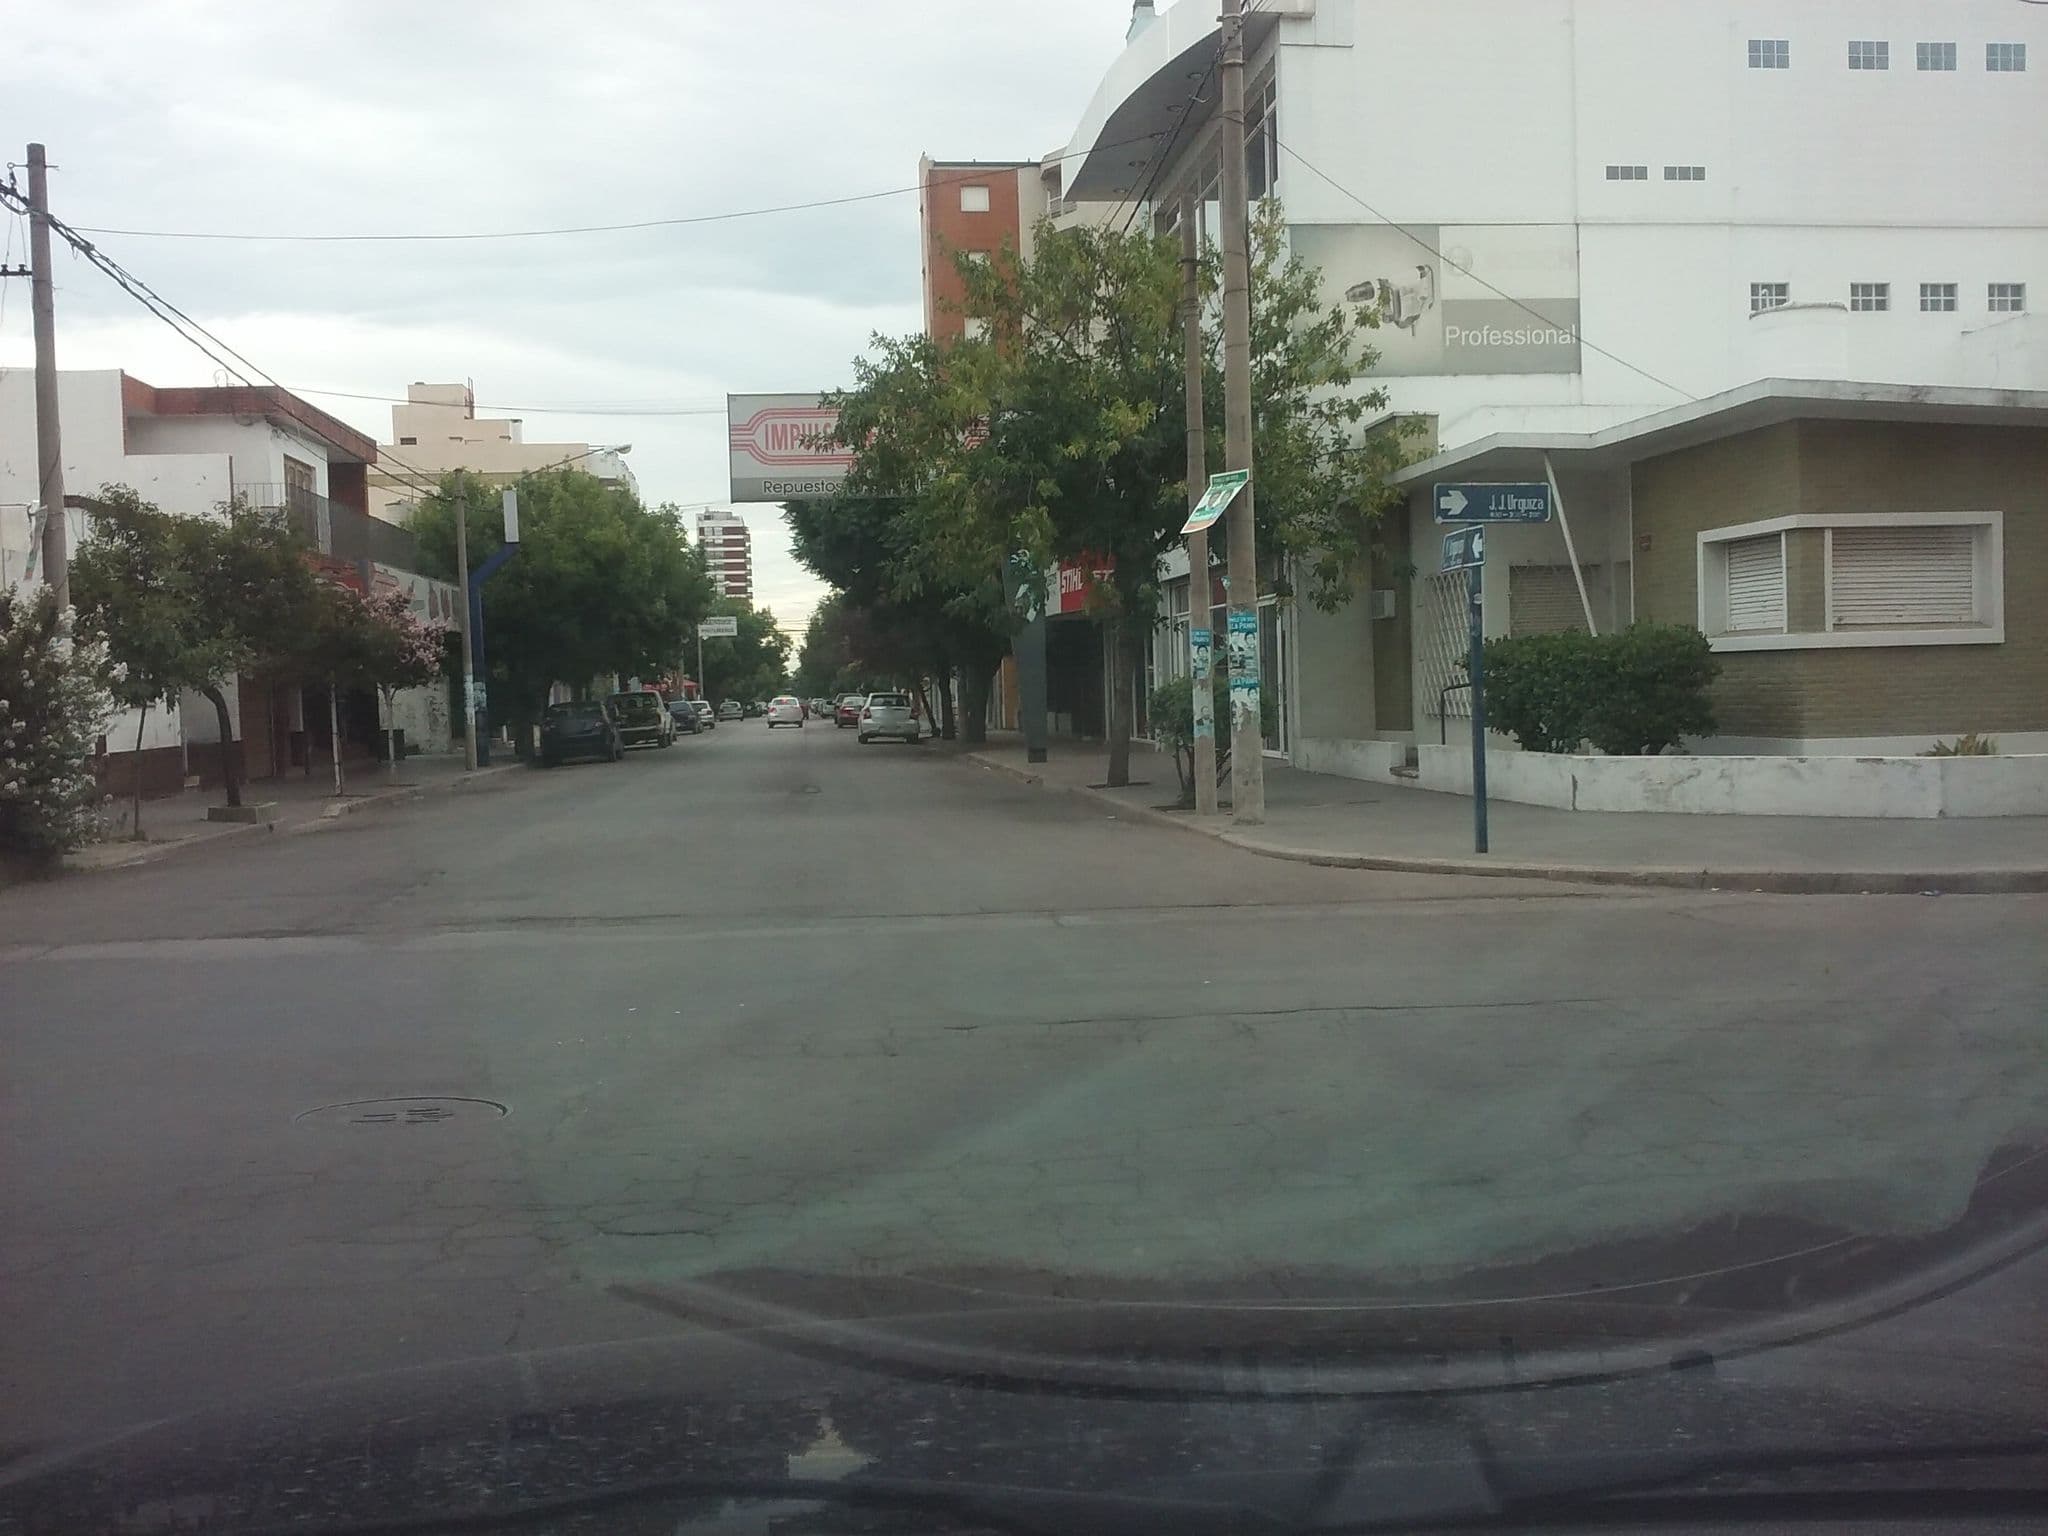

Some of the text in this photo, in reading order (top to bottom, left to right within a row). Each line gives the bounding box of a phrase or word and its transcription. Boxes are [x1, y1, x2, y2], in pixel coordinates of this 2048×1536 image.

[1445, 325, 1576, 346] Professional
[1507, 494, 1544, 513] Urquiza
[1061, 567, 1084, 594] STIHL
